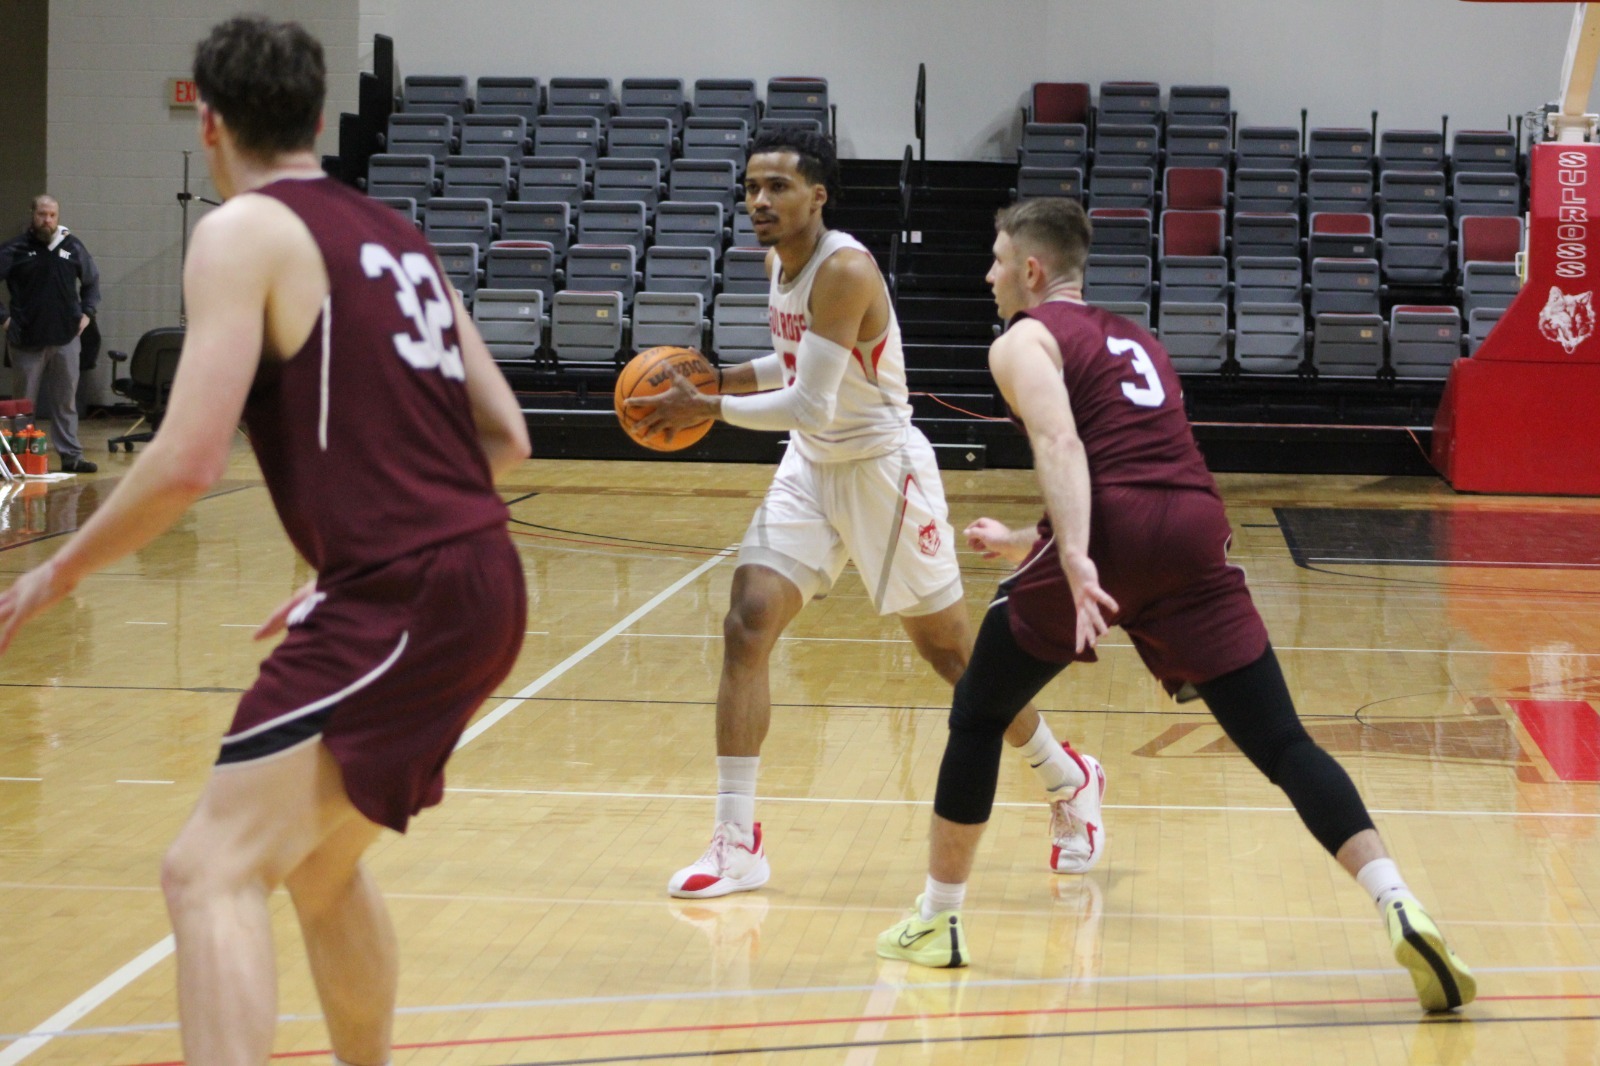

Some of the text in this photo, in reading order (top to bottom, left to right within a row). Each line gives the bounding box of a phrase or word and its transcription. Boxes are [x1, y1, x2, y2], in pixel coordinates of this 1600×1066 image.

[176, 81, 197, 102] EXI
[360, 243, 466, 381] 32
[1106, 336, 1166, 407] 3
